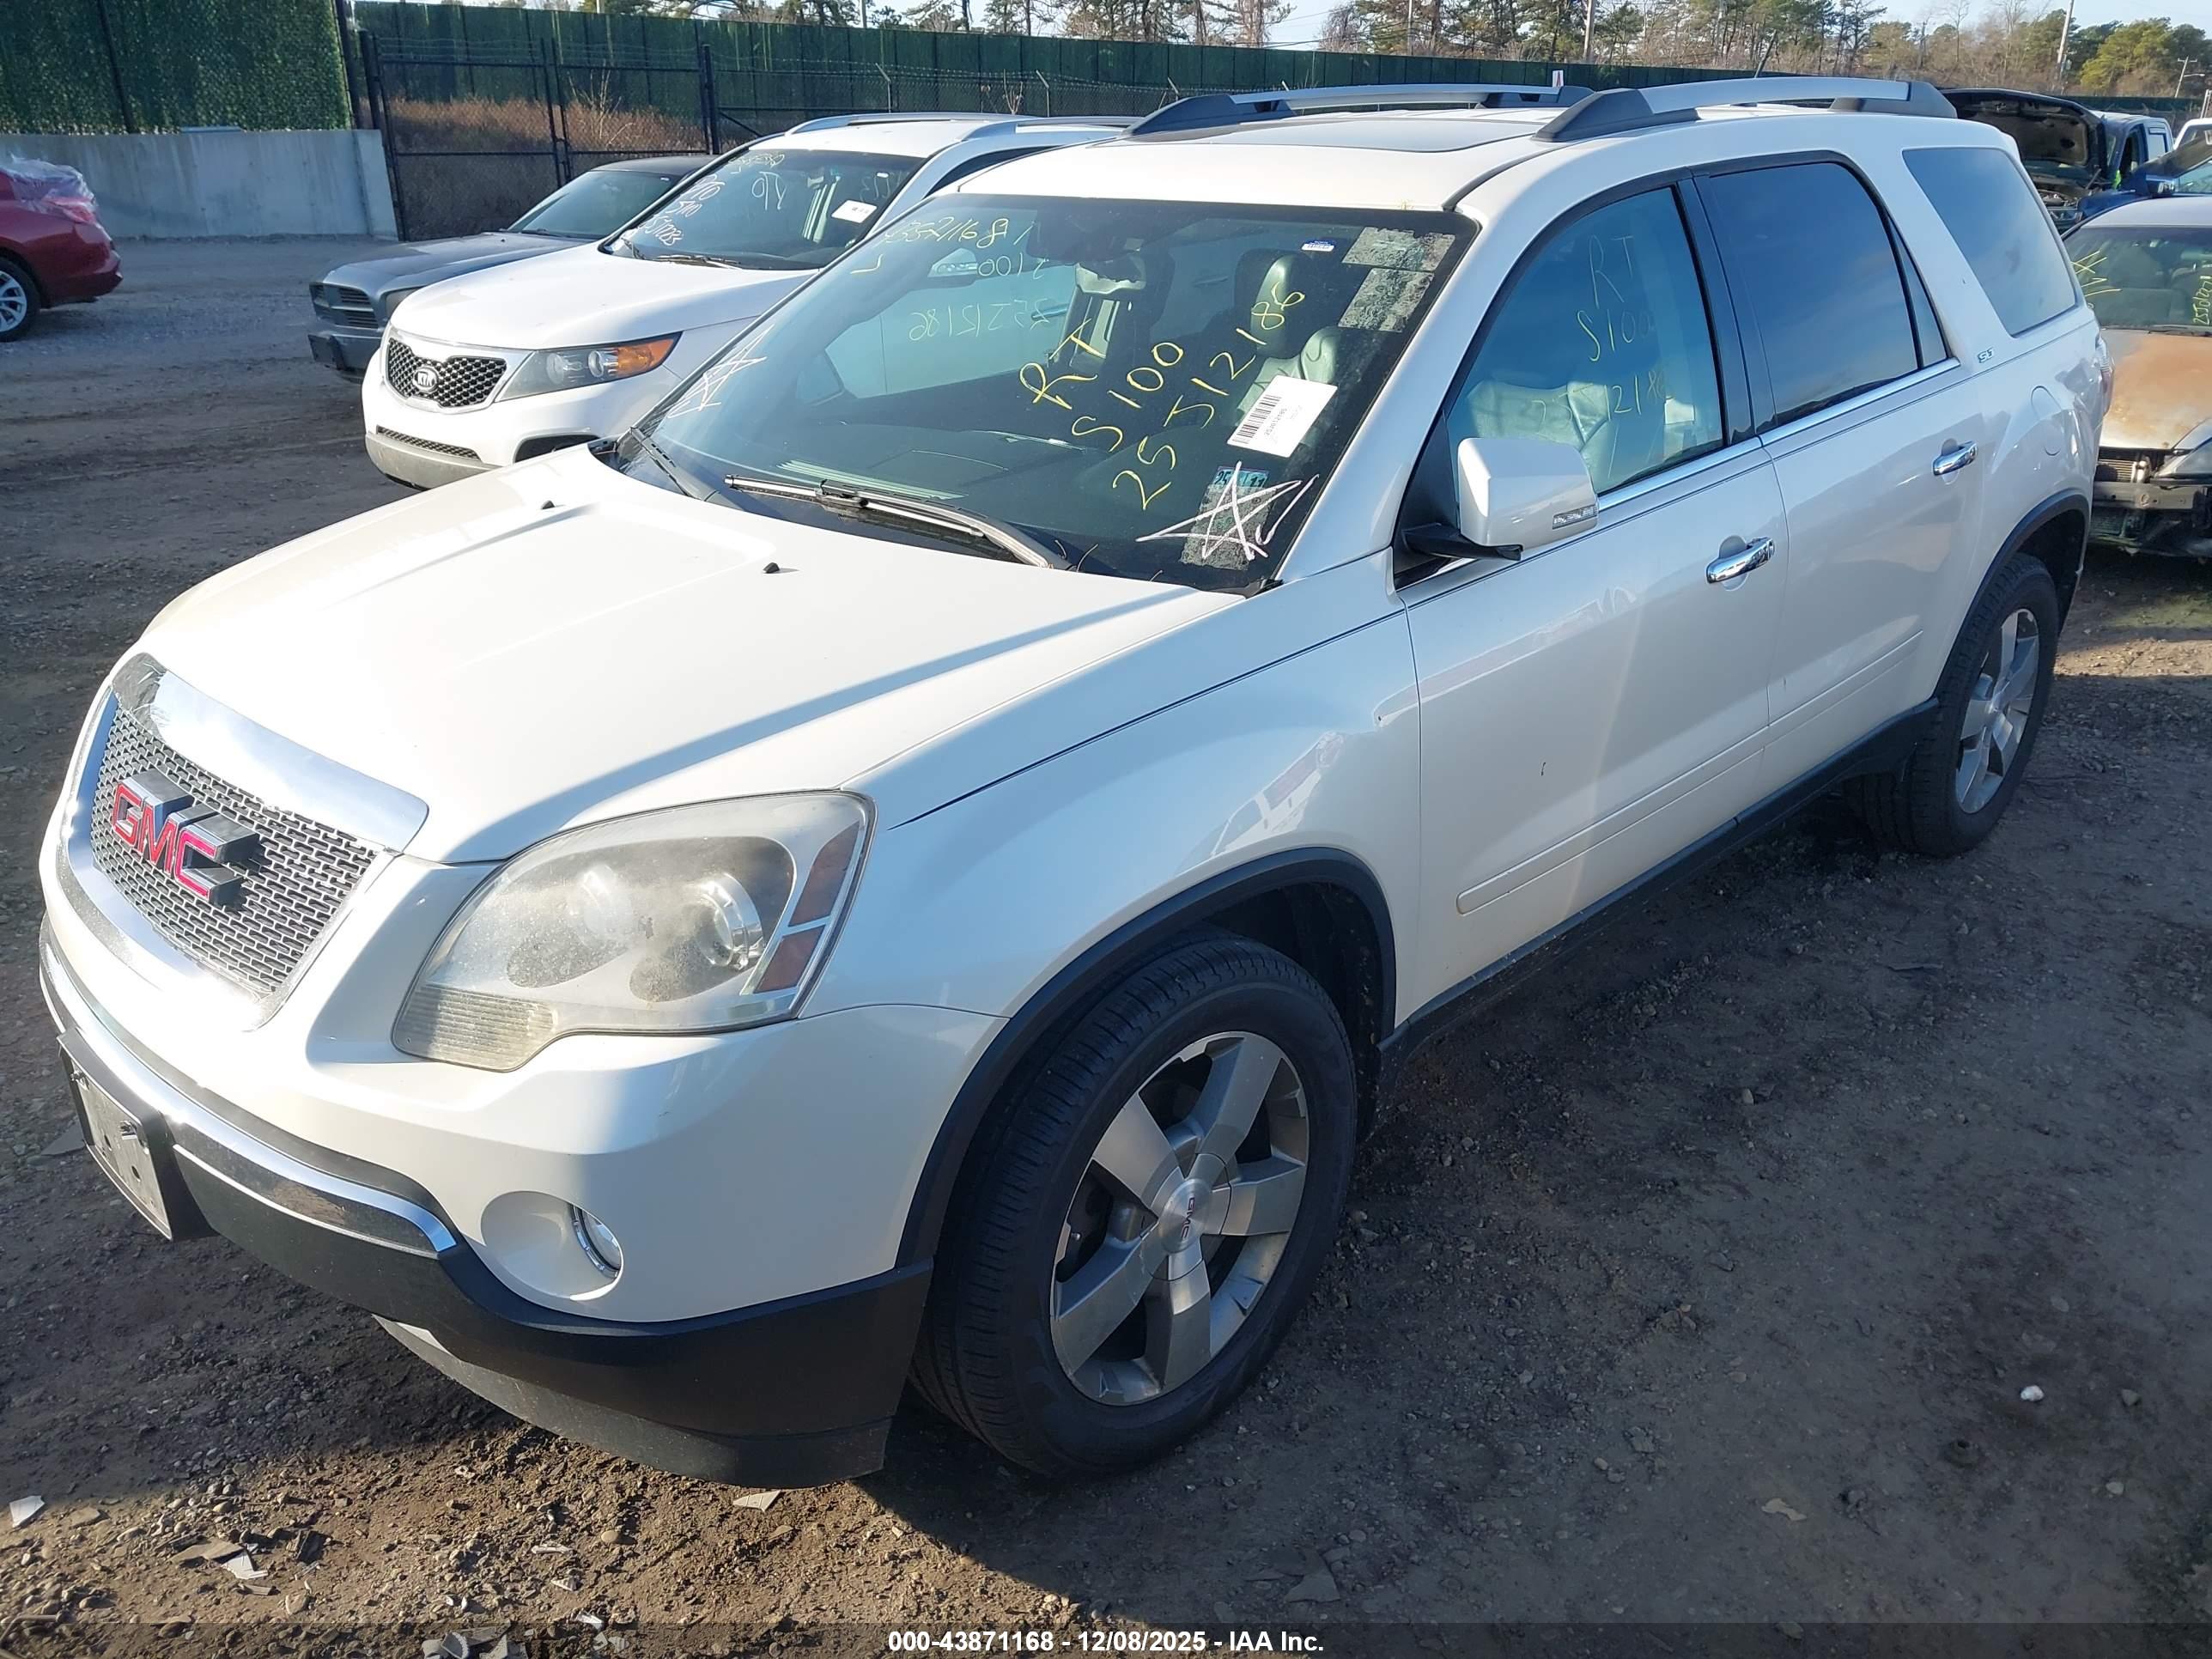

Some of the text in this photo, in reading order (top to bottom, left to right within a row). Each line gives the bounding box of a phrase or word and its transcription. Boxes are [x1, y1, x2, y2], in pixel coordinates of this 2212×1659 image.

[1072, 342, 1183, 452] S100
[112, 780, 221, 902] GMC
[1182, 1196, 1195, 1238] GMC
